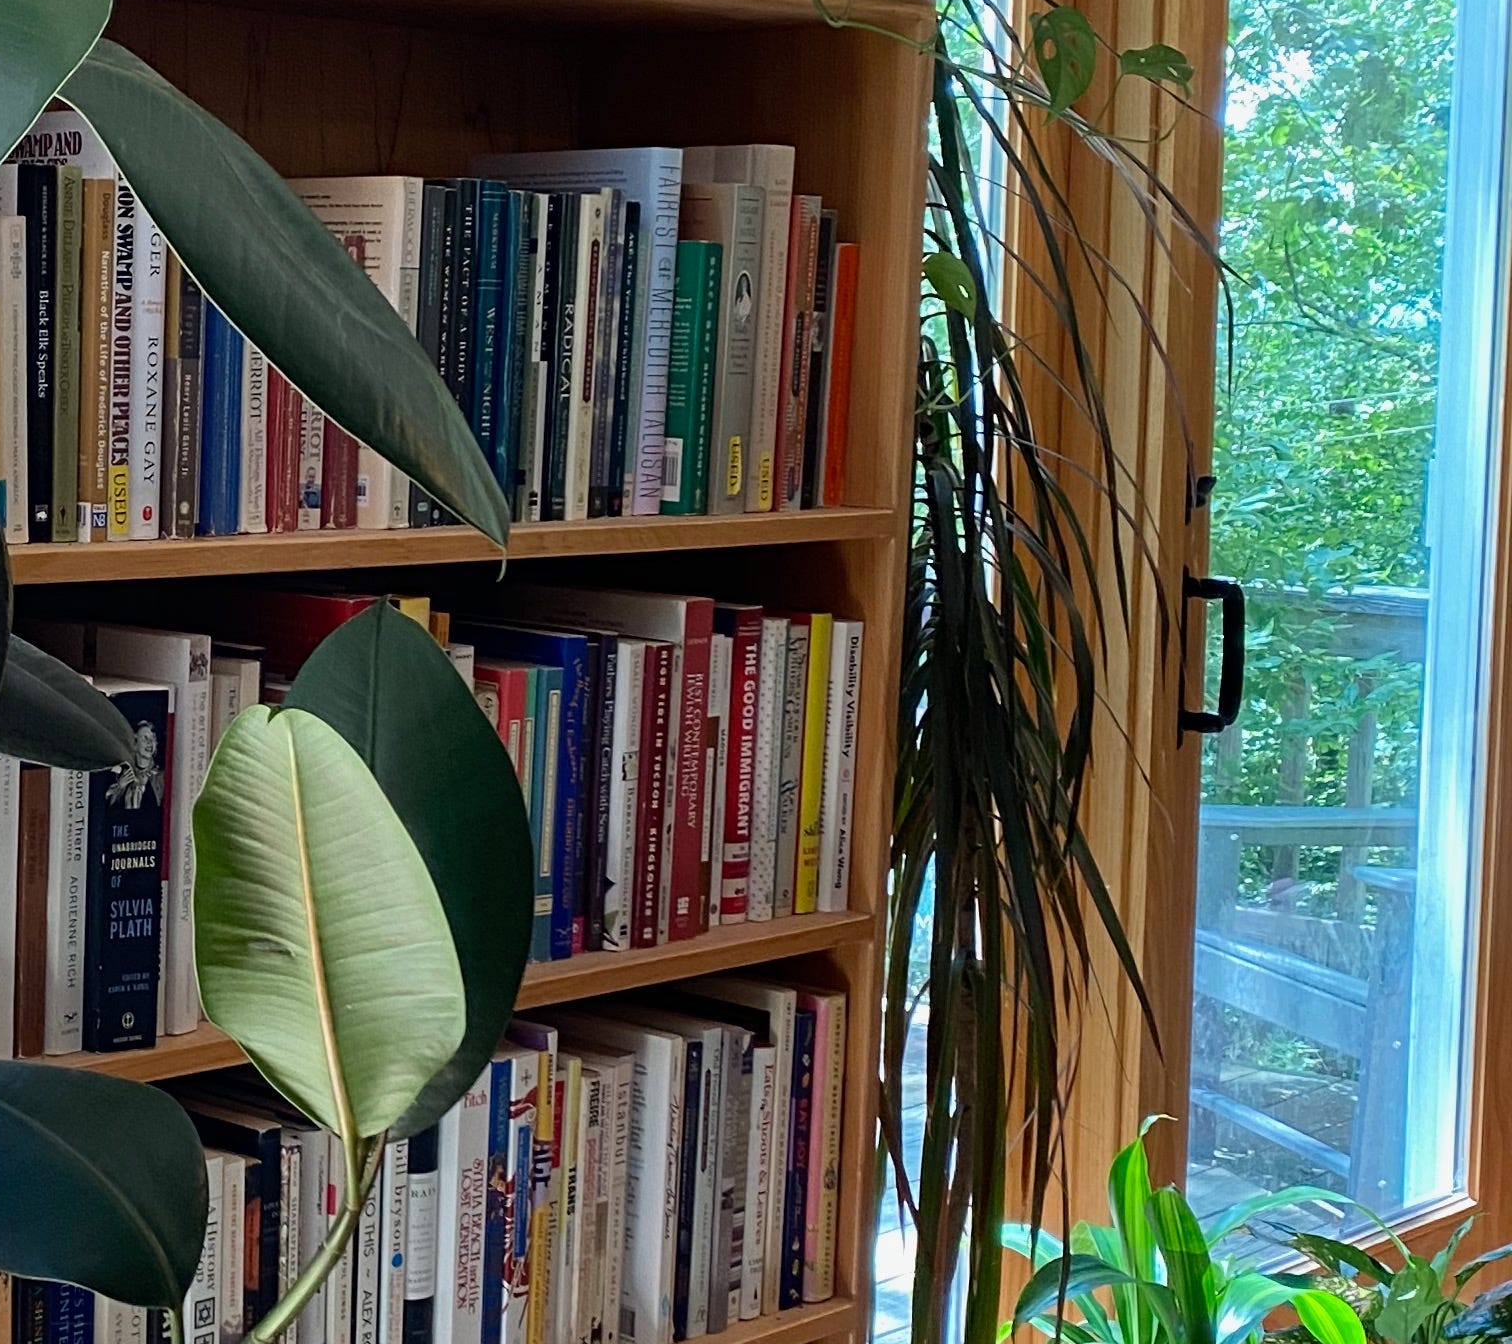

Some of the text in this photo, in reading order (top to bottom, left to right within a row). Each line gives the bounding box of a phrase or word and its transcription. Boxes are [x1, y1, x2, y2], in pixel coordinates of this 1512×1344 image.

[54, 131, 82, 156] AND
[63, 175, 76, 217] ANNIE
[100, 192, 111, 241] Douglass
[463, 205, 474, 239] THE
[655, 166, 682, 249] FAIREST
[61, 219, 75, 273] DILLARD
[461, 247, 472, 289] FACT
[490, 212, 500, 271] MARKHAM
[441, 226, 454, 326] THE WOMAN
[60, 284, 74, 327] PILGRIM
[459, 295, 470, 318] OF
[484, 306, 497, 356] WEST
[589, 296, 597, 336] LOLITA
[36, 290, 49, 398] Black Elk Speaks
[95, 250, 110, 490] Narrative of the Life of Frederick Douglass
[110, 223, 134, 466] SWAMP AND OTHER PLACES
[457, 341, 468, 385] BODY
[559, 304, 575, 402] RADICAL
[143, 336, 160, 485] ROXANE GAY
[182, 374, 192, 402] Henry
[481, 383, 492, 441] NIGHT
[639, 288, 675, 499] MEREDITH TALUSAN
[181, 404, 191, 431] Louis
[309, 412, 322, 462] RIOT
[729, 442, 741, 488] USED
[760, 457, 771, 501] USED
[113, 473, 128, 526] USED
[199, 716, 207, 734] art
[842, 636, 860, 758] Disability Visibility
[597, 653, 617, 844] Fathers Playing Catch with Sons
[651, 650, 668, 809] HIGH TIDE IN TUCSON
[680, 673, 697, 797] JEWISH WRITING
[687, 673, 705, 829] BEST CONTEMPORARY
[736, 643, 757, 837] THE GOOD IMMIGRANT
[73, 769, 86, 862] ound There
[112, 825, 129, 838] THE
[625, 787, 635, 840] BARBARA
[110, 855, 156, 871] JOURNALS
[111, 839, 157, 854] UNABRIDGED
[644, 827, 658, 918] KINGSOLVER
[834, 828, 847, 889] Alice Wong
[110, 874, 122, 888] OF
[181, 834, 193, 922] Wendell Berry
[67, 875, 80, 989] ADRIENNE RICH
[109, 917, 153, 940] PLATH
[110, 898, 154, 920] SYLVIA
[463, 1091, 488, 1108] Fitch
[588, 1080, 601, 1128] FREIRE
[615, 1081, 630, 1167] Istanbul
[795, 1097, 809, 1169] EAT JOY
[390, 1142, 409, 1253] bill bryson
[566, 1164, 578, 1216] TRANS
[754, 1110, 772, 1246] Shoots & Leaves
[289, 1196, 299, 1274] SHAKESPEARE
[362, 1194, 376, 1258] TO THIS
[456, 1168, 472, 1311] LOST GENERATION
[467, 1157, 485, 1315] SYLVIA BEACH and the
[206, 1221, 218, 1292] HISTORY
[361, 1289, 374, 1325] ALEX
